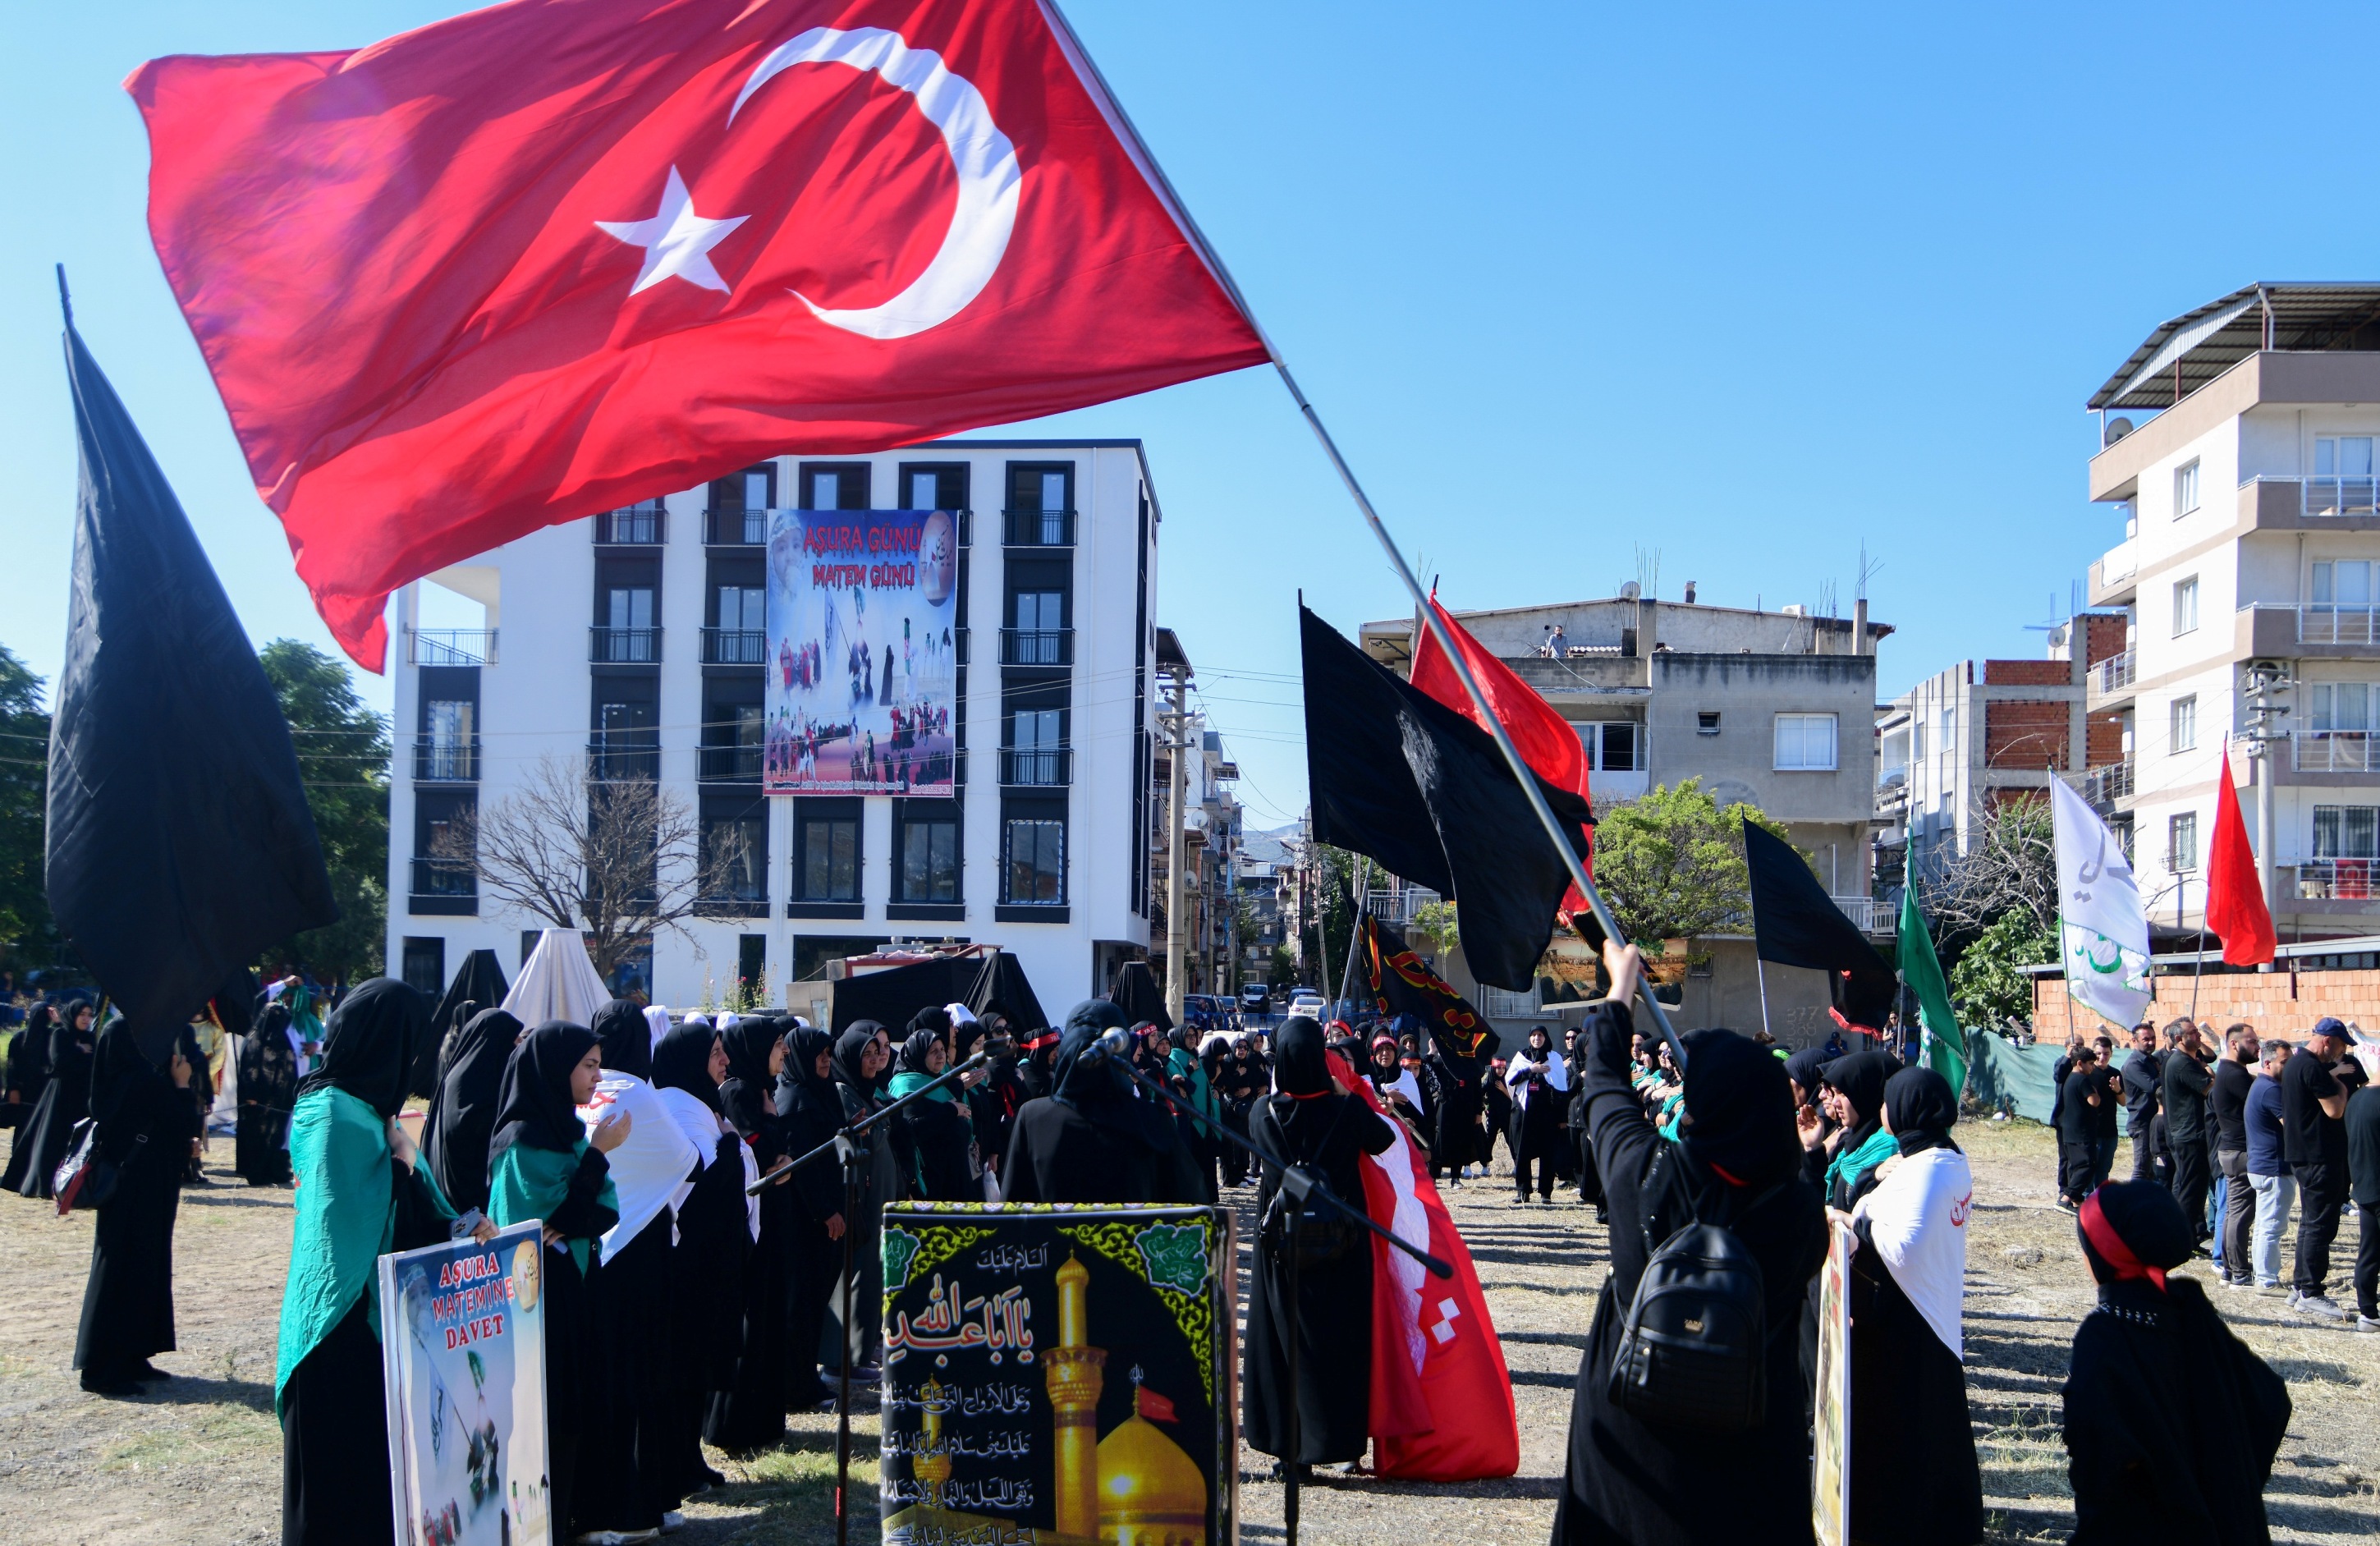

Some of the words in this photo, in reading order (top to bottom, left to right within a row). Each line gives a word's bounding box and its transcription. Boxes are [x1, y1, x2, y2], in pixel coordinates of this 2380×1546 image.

[803, 525, 862, 556] AŞURA
[868, 523, 921, 554] GÜNÜ
[813, 564, 866, 589] MATEM
[870, 562, 915, 589] GÜNÜ
[438, 1251, 500, 1288] AŞURA
[433, 1276, 516, 1324] MATEMİNE
[446, 1313, 504, 1351] DAVET
